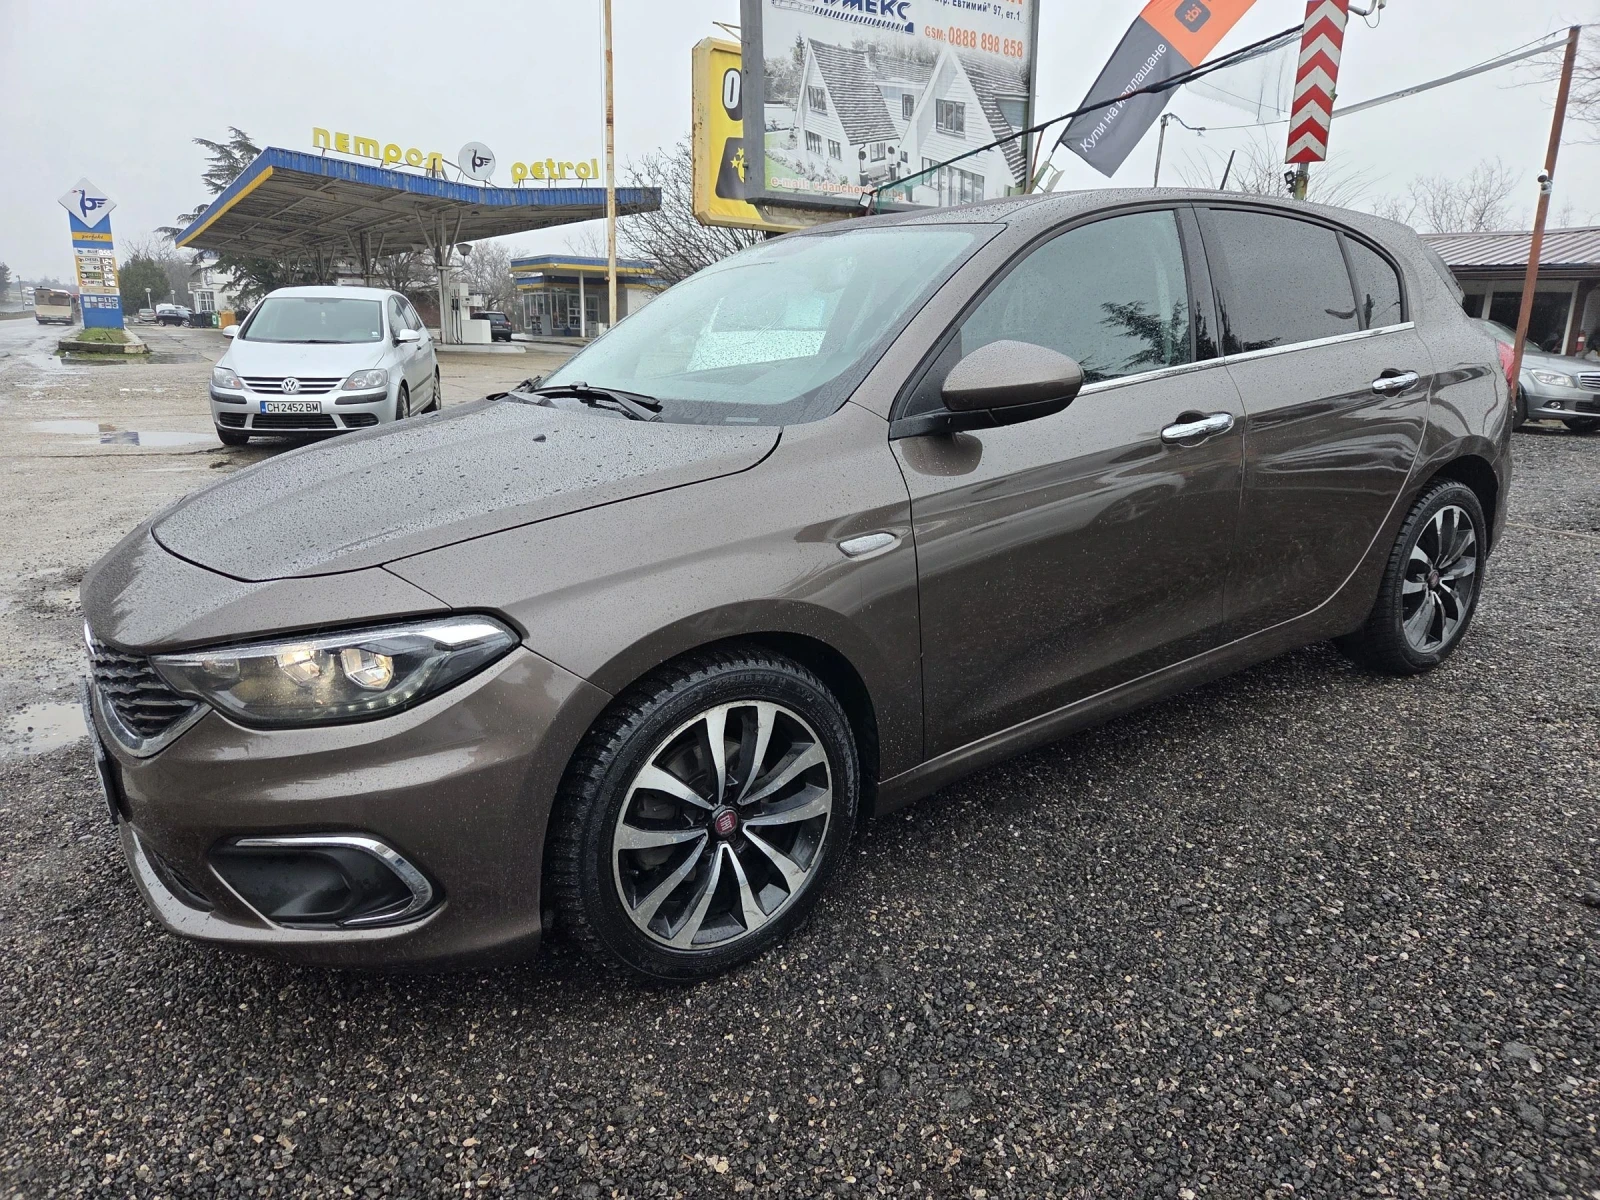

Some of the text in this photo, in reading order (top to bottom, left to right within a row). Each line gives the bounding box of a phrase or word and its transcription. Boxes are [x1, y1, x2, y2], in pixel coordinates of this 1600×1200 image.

[925, 25, 1023, 58] GSM: 0888 898 858
[1079, 122, 1107, 153] Купи
[1103, 106, 1119, 124] на
[511, 158, 599, 183] petrol
[770, 176, 810, 191] e-mail:
[267, 403, 280, 412] CH
[281, 403, 304, 412] 2452
[305, 403, 319, 412] BM
